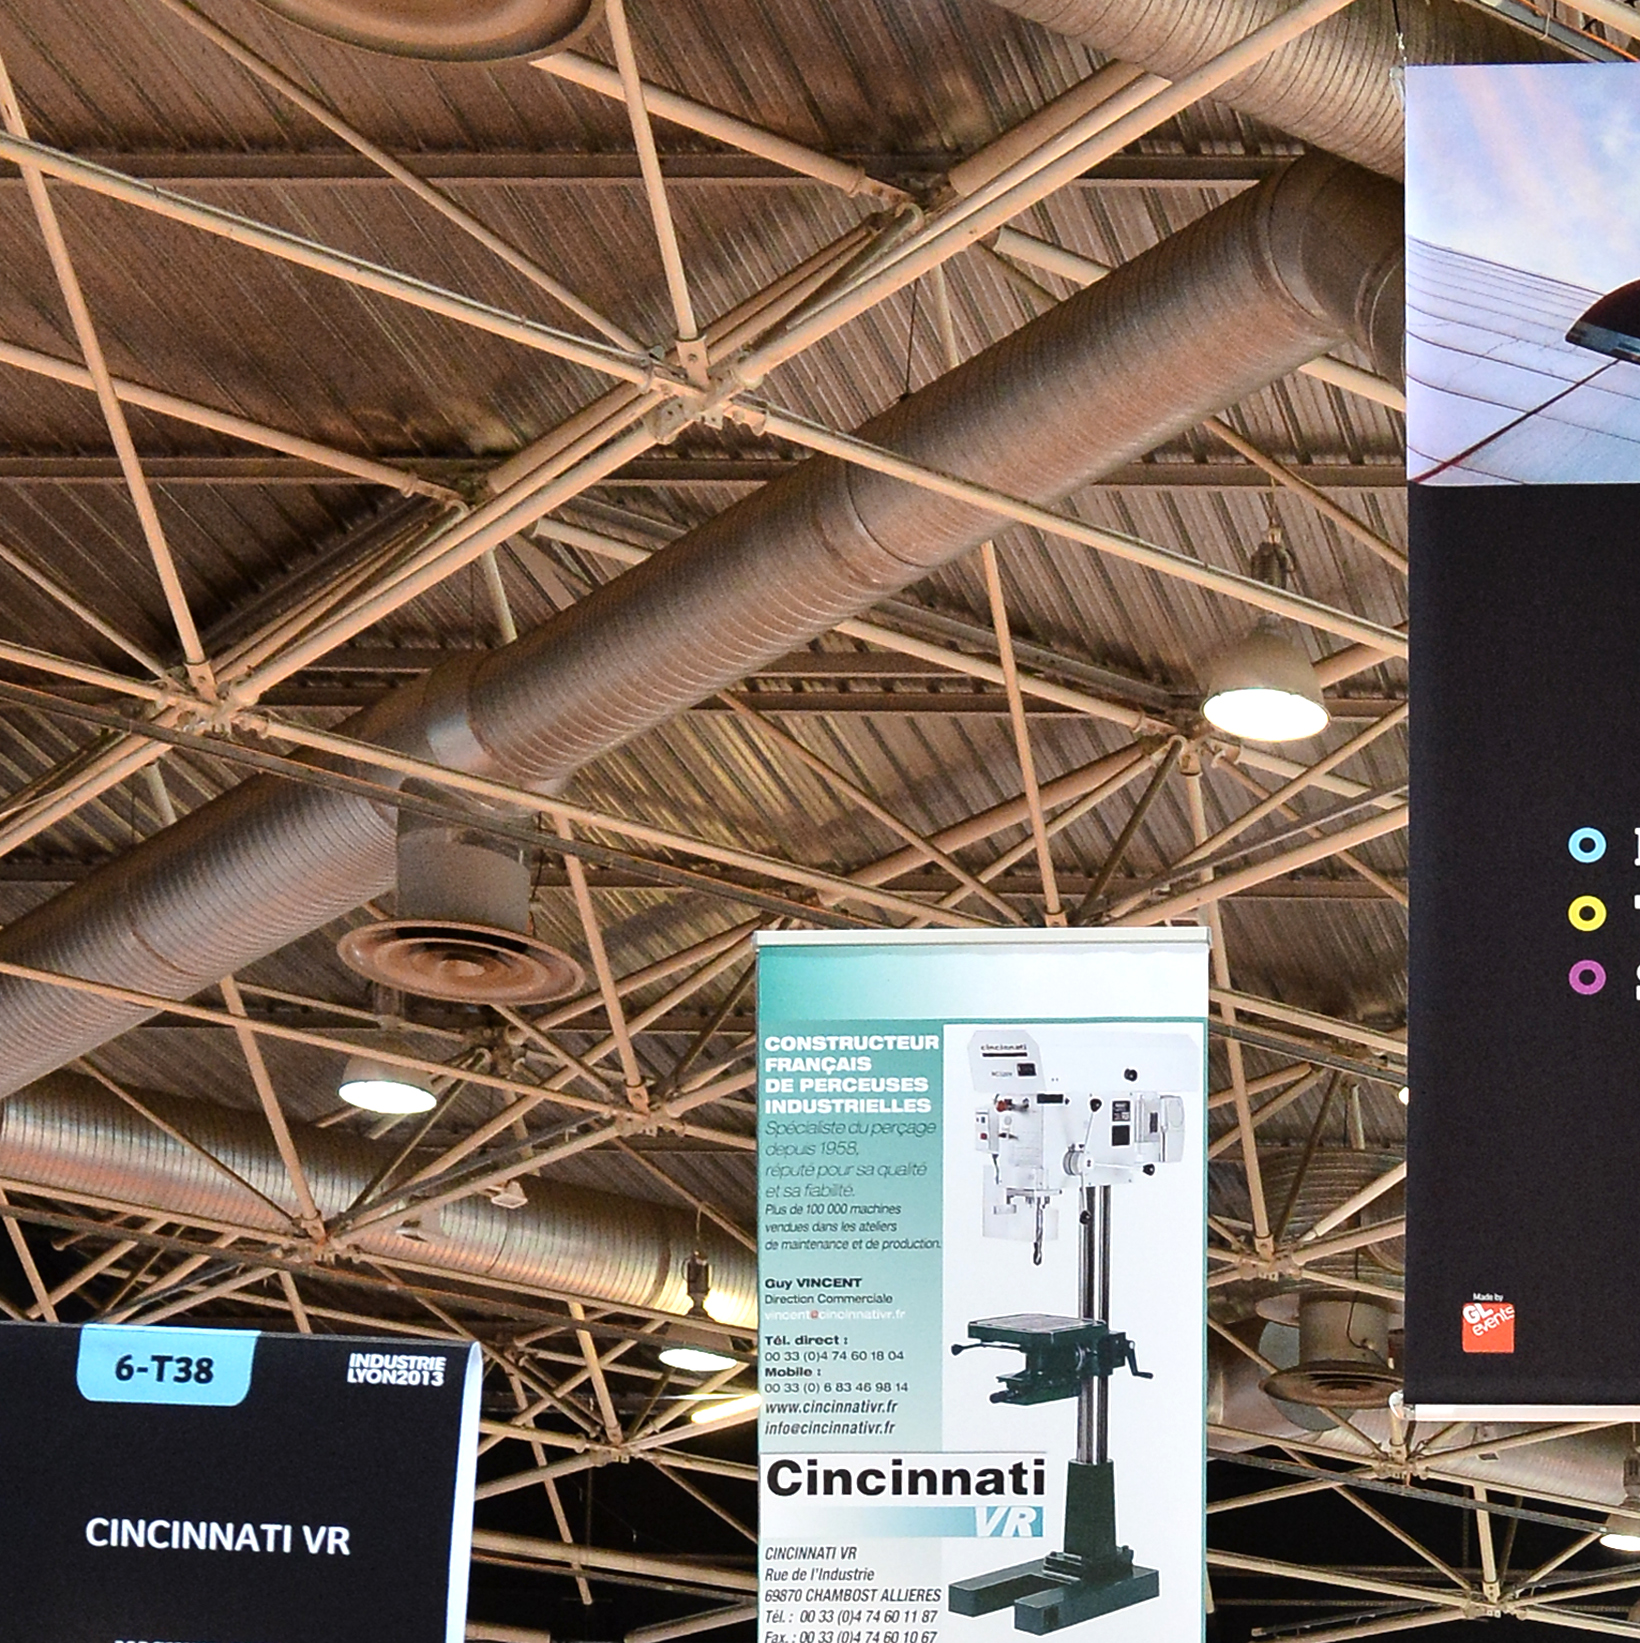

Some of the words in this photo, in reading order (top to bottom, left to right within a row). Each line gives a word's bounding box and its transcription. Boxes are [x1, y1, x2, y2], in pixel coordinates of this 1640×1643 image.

[765, 1035, 939, 1051] CONSTRUCTEUR
[765, 1057, 872, 1075] FRANÇAIS
[765, 1078, 794, 1093] DE
[800, 1077, 928, 1092] PERCEUSES
[765, 1098, 932, 1114] INDUSTRIELLES
[848, 1122, 869, 1134] du
[870, 1122, 937, 1138] perçage
[765, 1143, 816, 1158] depuis
[817, 1165, 854, 1178] pour
[856, 1166, 874, 1176] sa
[878, 1162, 927, 1178] qualité
[766, 1185, 780, 1198] et
[783, 1187, 800, 1197] sa
[765, 1204, 787, 1215] Plus
[790, 1205, 803, 1214] de
[807, 1204, 824, 1214] 100
[828, 1203, 847, 1214] 000
[851, 1203, 902, 1214] machines
[765, 1222, 809, 1232] vendues
[812, 1222, 838, 1232] dans
[841, 1222, 855, 1232] les
[859, 1221, 897, 1232] ateliers
[765, 1240, 779, 1250] de
[781, 1240, 849, 1249] maintenance
[852, 1239, 863, 1249] et
[866, 1239, 879, 1249] de
[765, 1278, 792, 1290] Guy
[796, 1278, 862, 1288] VINCENT
[765, 1294, 814, 1304] Direction
[818, 1293, 893, 1304] Commerciale
[1472, 1305, 1515, 1336] events
[765, 1336, 790, 1345] Tél.
[795, 1336, 839, 1345] direct
[349, 1353, 447, 1371] INDUSTRIE
[765, 1352, 780, 1361] 00
[784, 1352, 799, 1361] 33
[803, 1351, 828, 1363] (0)4
[833, 1351, 847, 1360] 74
[851, 1351, 867, 1360] 60
[872, 1351, 884, 1360] 18
[888, 1351, 904, 1360] 04
[115, 1354, 214, 1384] 6-T38
[347, 1367, 445, 1386] LYON2013
[765, 1367, 812, 1377] Mobile
[765, 1383, 780, 1393] 00
[784, 1383, 799, 1392] 33
[803, 1383, 820, 1394] (0)
[824, 1383, 832, 1392] 6
[835, 1383, 851, 1392] 83
[855, 1383, 871, 1392] 46
[875, 1383, 891, 1392] 98
[896, 1383, 908, 1392] 14
[765, 1399, 898, 1414] www.cincinnativr.fr
[765, 1420, 895, 1435] info@cincinnativr.fr
[767, 1459, 1045, 1497] Cincinnati
[974, 1506, 1038, 1537] VR
[85, 1517, 291, 1553] CINCINNATI
[303, 1525, 351, 1555] VR
[765, 1547, 837, 1560] CINCINNATI
[840, 1547, 858, 1560] VR
[765, 1568, 788, 1581] Rue
[792, 1568, 807, 1581] de
[811, 1567, 875, 1581] l'Industrie
[765, 1589, 802, 1602] 69870
[806, 1589, 878, 1602] CHAMBOST
[880, 1589, 942, 1602] ALLIERES
[766, 1610, 785, 1623] Tél.
[800, 1610, 815, 1623] 00
[818, 1610, 834, 1623] 33
[838, 1610, 862, 1625] (0)4
[866, 1610, 881, 1623] 74
[884, 1610, 900, 1623] 60
[904, 1610, 917, 1623] 11
[922, 1610, 938, 1623] 87
[765, 1631, 788, 1643] Fax.
[800, 1631, 815, 1643] 00
[818, 1631, 833, 1643] 33
[865, 1631, 880, 1643] 74
[884, 1631, 899, 1643] 60
[904, 1631, 918, 1643] 10
[921, 1631, 938, 1643] 67
